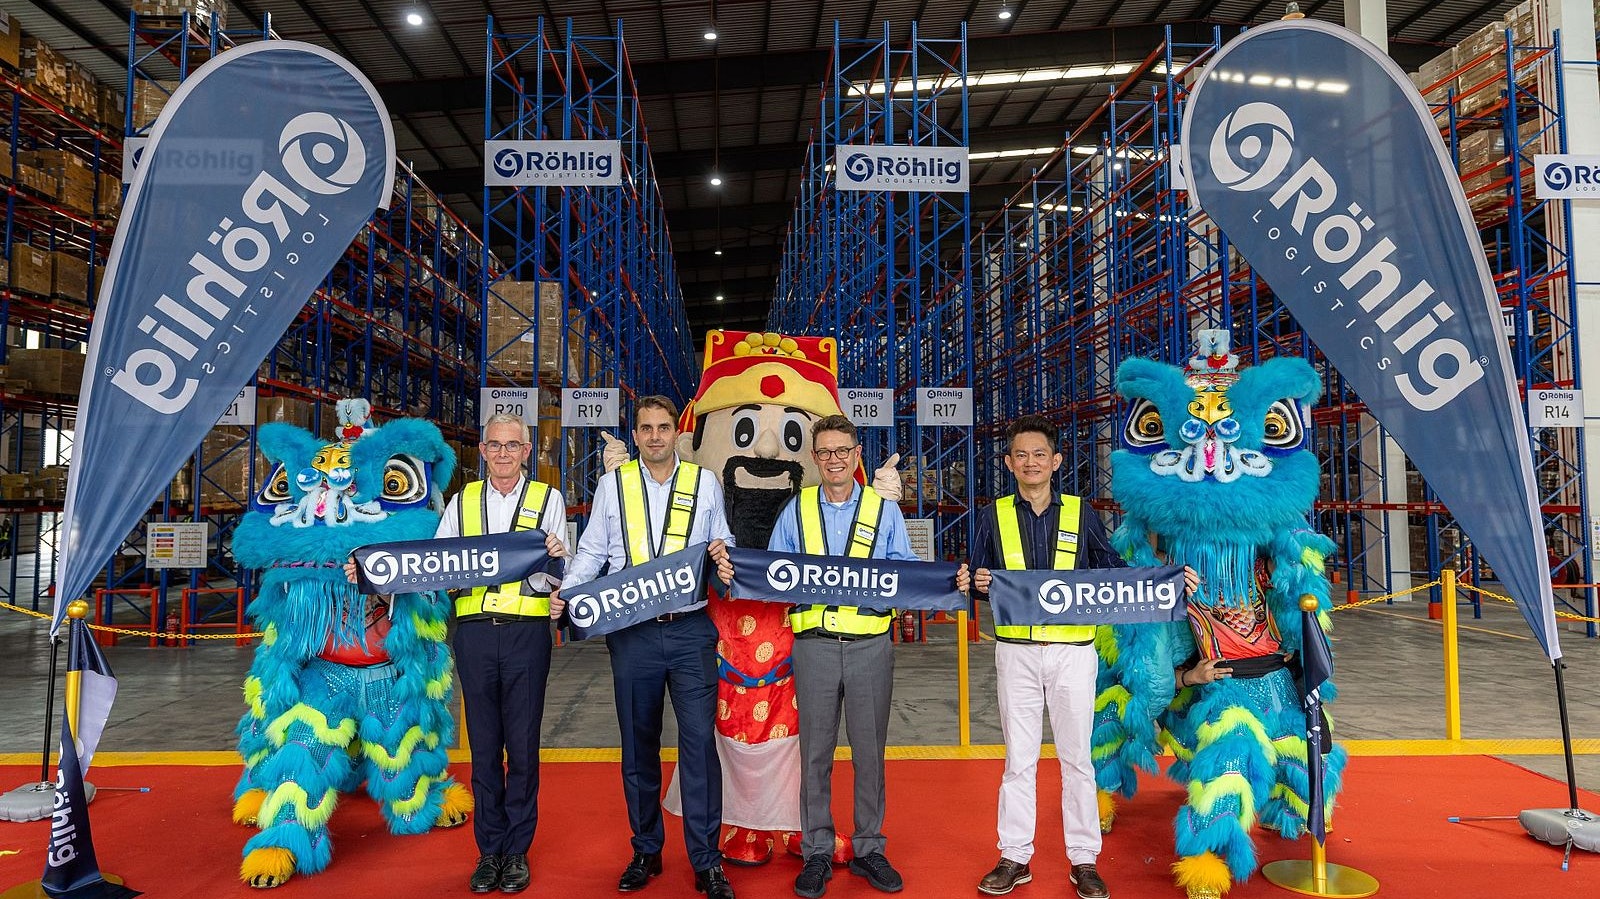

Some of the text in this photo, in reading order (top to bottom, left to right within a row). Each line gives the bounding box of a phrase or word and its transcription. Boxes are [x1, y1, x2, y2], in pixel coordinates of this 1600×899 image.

[527, 152, 612, 178] Röhlig
[877, 157, 961, 184] Röhlig
[1252, 209, 1391, 371] LOGISTICS
[501, 390, 528, 399] Röhlig
[582, 391, 609, 399] Röhlig
[857, 391, 883, 400] Röhlig
[936, 390, 963, 399] Röhlig
[1548, 392, 1574, 400] Röhlig
[225, 403, 238, 416] 21
[495, 404, 523, 416] R20
[578, 404, 603, 418] R19
[853, 405, 878, 417] R18
[933, 404, 957, 417] R17
[1545, 406, 1569, 418] R14
[401, 548, 499, 577] Röhlig
[402, 573, 479, 583] LOGISTICS
[802, 564, 899, 597] Röhlig
[599, 565, 696, 612] Röhlig
[802, 588, 877, 597] LOGISTICS
[1075, 580, 1176, 610] Röhlig
[606, 592, 679, 621] LOGISTICS
[1076, 605, 1155, 614] LOGISTICS
